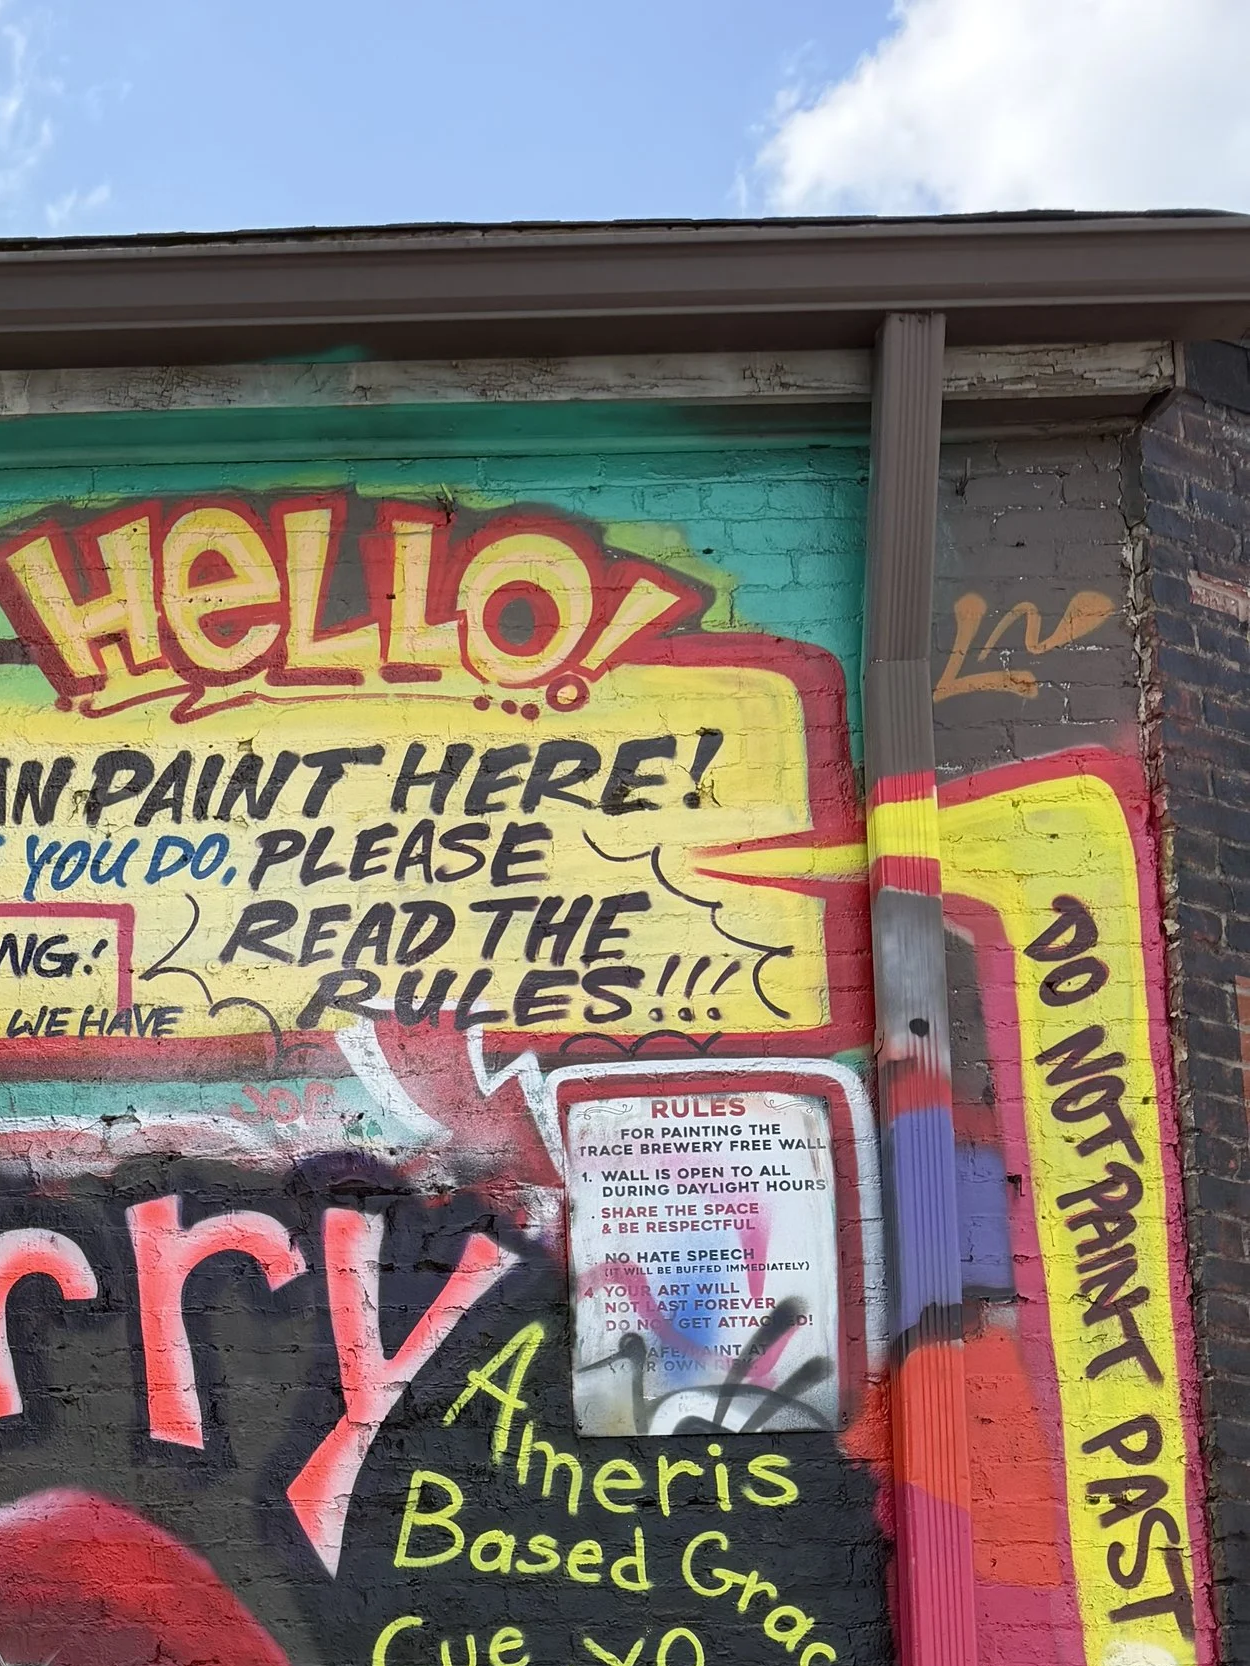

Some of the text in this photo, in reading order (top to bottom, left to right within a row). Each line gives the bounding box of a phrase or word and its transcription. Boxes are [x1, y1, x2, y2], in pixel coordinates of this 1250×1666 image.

[84, 744, 384, 827] PAINT
[391, 730, 724, 817] HERE!
[25, 833, 141, 900] YOU
[248, 821, 550, 892] PLEASE
[218, 891, 651, 968] READ THE
[1022, 894, 1111, 1008] DO
[7, 1005, 73, 1039] WE
[78, 1003, 185, 1039] HAVE
[1034, 1023, 1144, 1166] NOT
[650, 1098, 747, 1119] RULES
[620, 1123, 782, 1140] FOR PAINTING THE
[579, 1138, 827, 1158] TRACE BREWERY FREE WALL
[601, 1169, 650, 1182] WALL
[655, 1168, 671, 1180] IS
[677, 1166, 725, 1180] OPEN
[730, 1165, 753, 1178] TO
[759, 1164, 792, 1177] ALL
[602, 1179, 827, 1198] DURING DAYLIGHT HOURS
[601, 1203, 760, 1219] SHARE THE SPACE
[601, 1218, 756, 1235] & BE RESPECTFUL
[604, 1248, 756, 1264] NO HATE SPEECH
[623, 1265, 654, 1276] WILL
[657, 1265, 673, 1275] BE
[676, 1264, 722, 1275] BUFFED
[725, 1261, 811, 1273] IMMEDIATELY)
[1055, 1160, 1165, 1386] PAINT
[604, 1284, 651, 1298] YOUR
[657, 1283, 691, 1296] ART
[696, 1282, 740, 1295] WILL
[604, 1301, 640, 1314] NOT
[693, 1297, 777, 1311] FOREVER
[605, 1314, 814, 1332] DO NO GET ATTACED!
[693, 1344, 743, 1358] AINT
[442, 1321, 800, 1517] Ameris
[393, 1468, 652, 1592] Based
[1081, 1411, 1197, 1644] PAST
